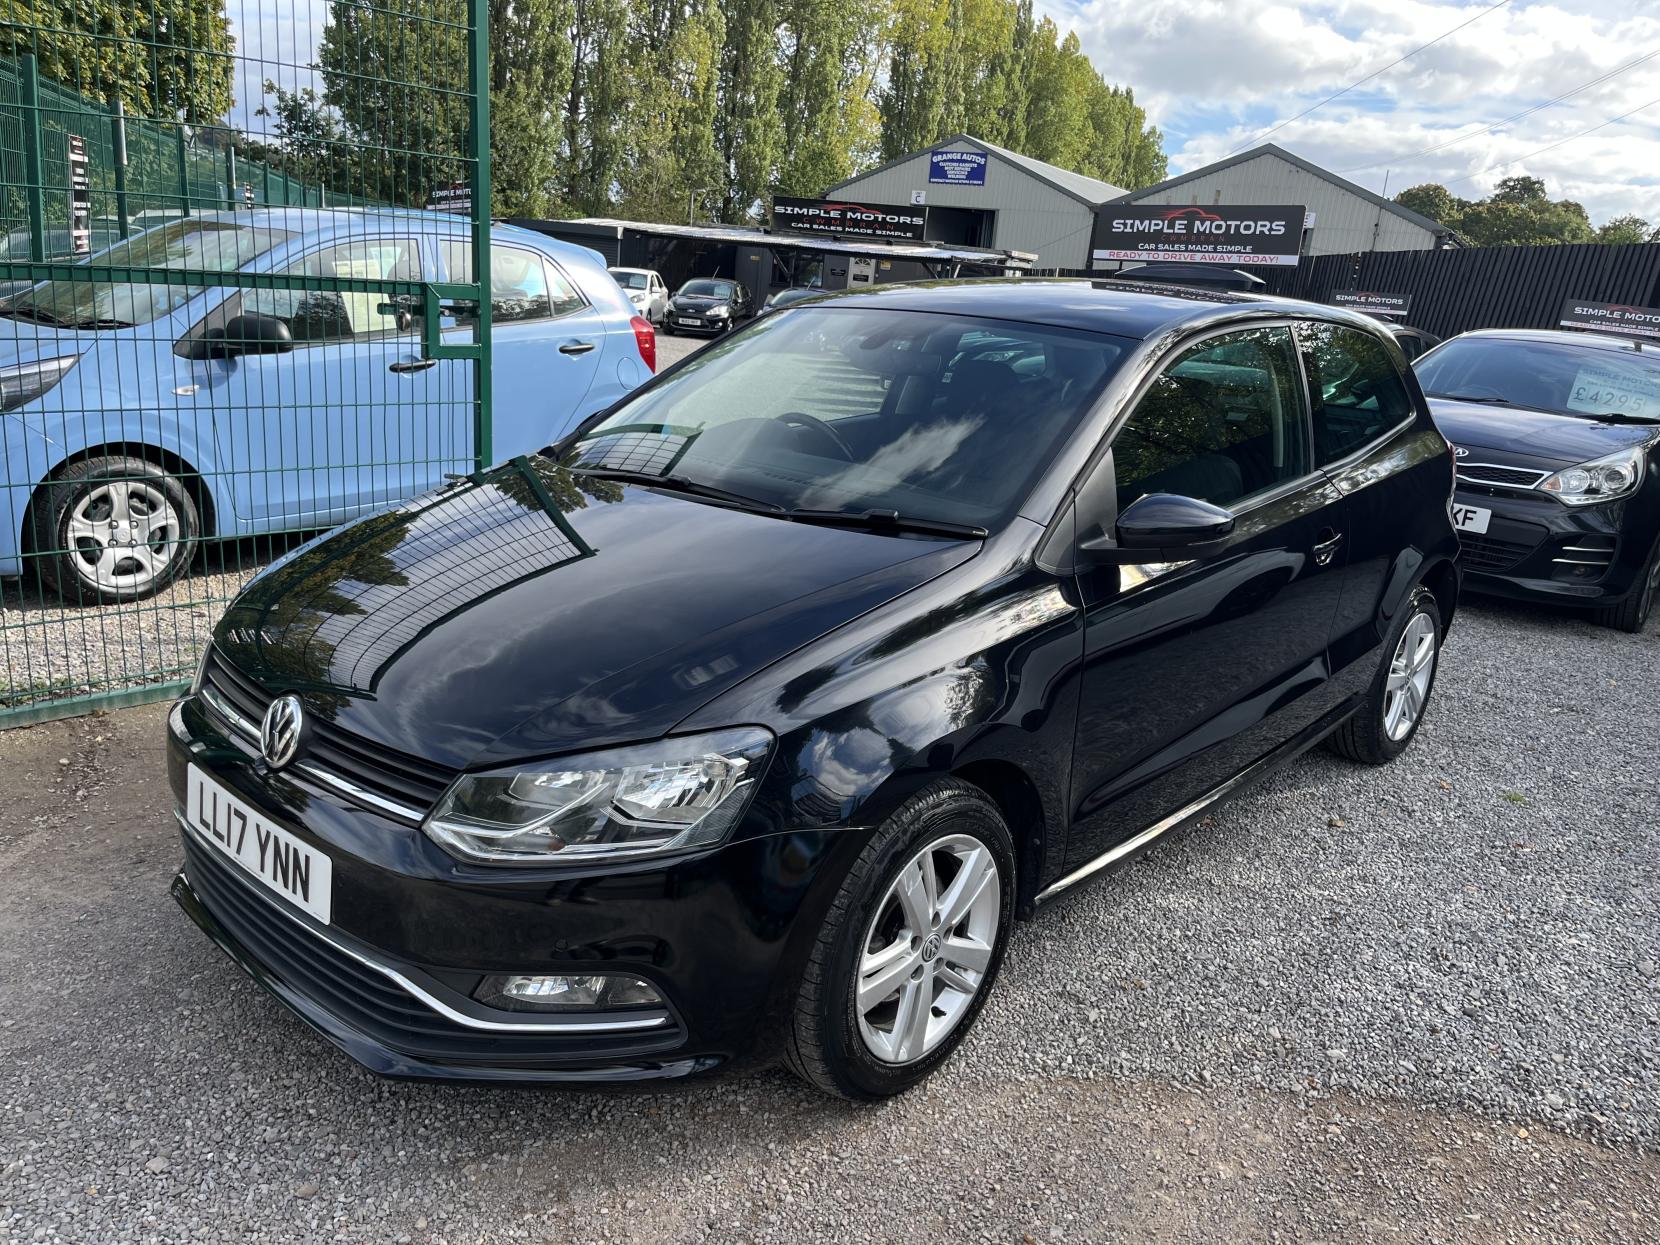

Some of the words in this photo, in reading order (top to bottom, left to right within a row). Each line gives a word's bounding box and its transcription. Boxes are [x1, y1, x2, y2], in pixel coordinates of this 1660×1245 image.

[932, 153, 961, 163] GRANGE
[962, 153, 986, 165] AUTOS
[915, 195, 921, 203] C
[774, 205, 841, 218] SIMPLE
[846, 211, 924, 225] MOTORS
[803, 217, 894, 231] CWMBRAN
[1112, 219, 1188, 234] SIMPLE
[1193, 220, 1286, 235] MOTORS
[875, 229, 913, 238] SIMPLE
[1157, 243, 1186, 251] SALES
[1187, 244, 1215, 252] MADE
[1216, 245, 1253, 253] SIMPLE
[1108, 251, 1144, 259] READY
[1145, 252, 1160, 260] TO
[1162, 252, 1197, 261] DRIVE
[1199, 254, 1234, 262] AWAY
[1236, 255, 1279, 264] TODAY!
[1335, 294, 1366, 302] SIMPLE
[1367, 297, 1404, 305] MOTORS
[1573, 306, 1622, 319] SIMPLE
[1573, 387, 1643, 411] £4295
[199, 781, 248, 856] LL17
[256, 822, 311, 904] YNN
